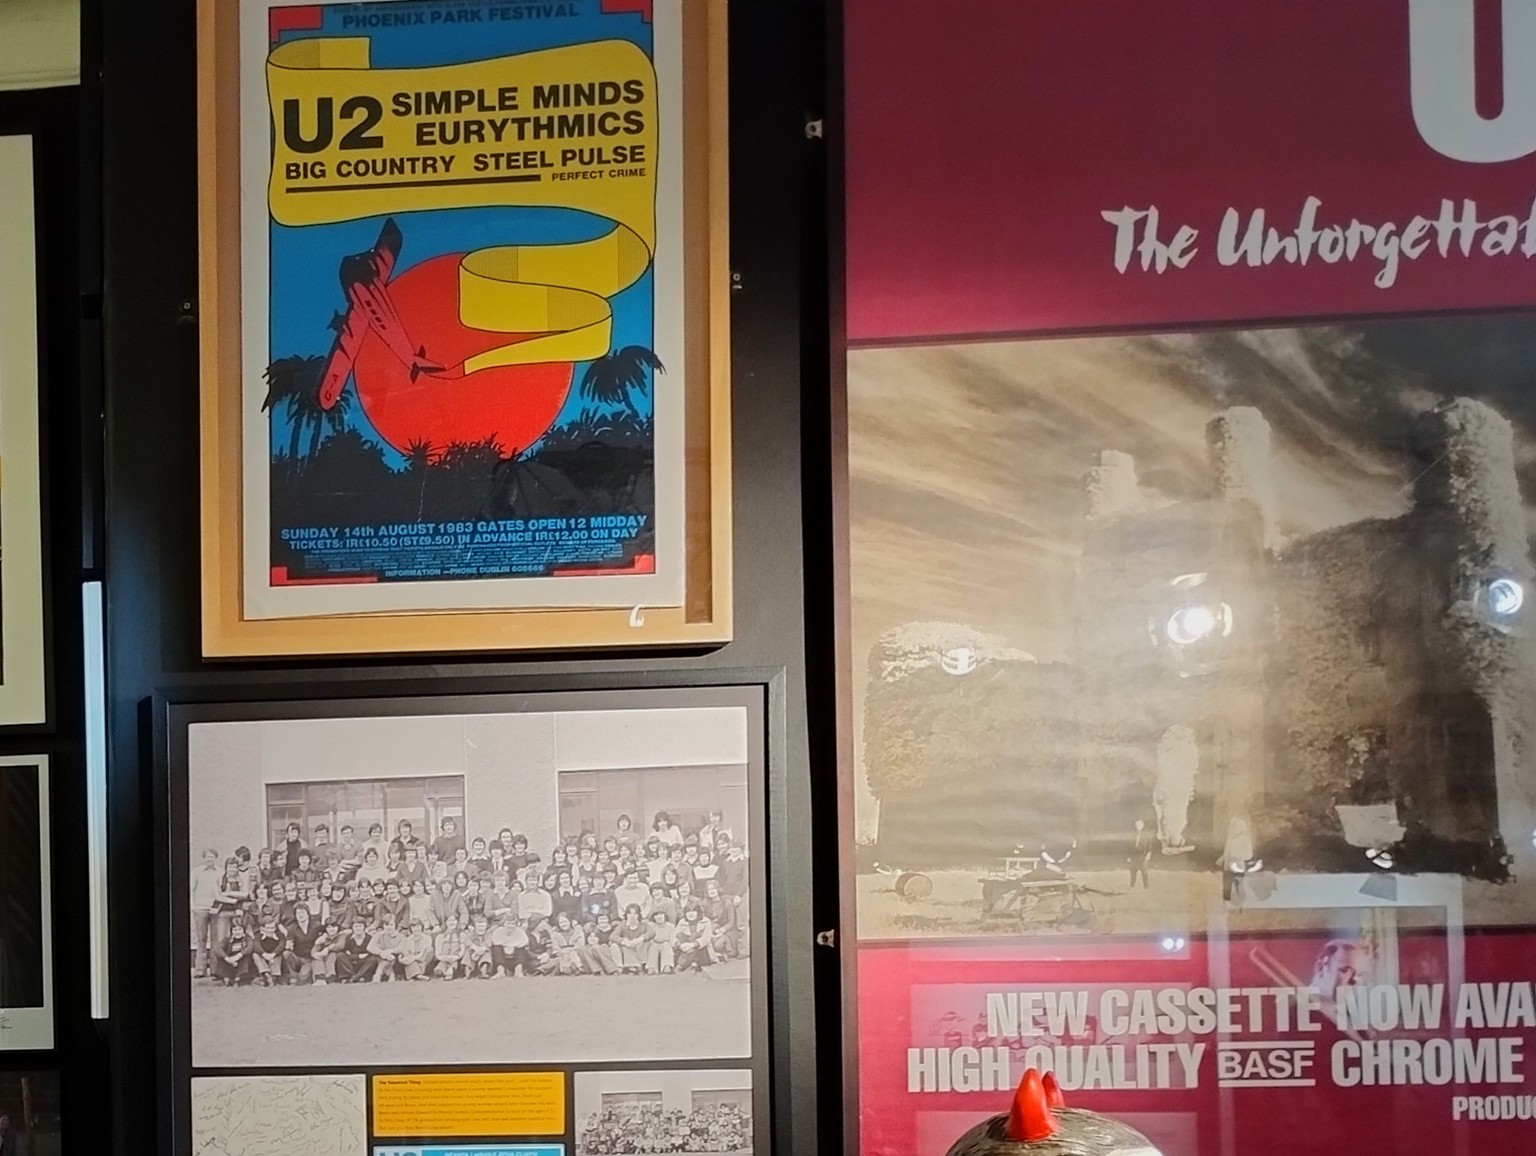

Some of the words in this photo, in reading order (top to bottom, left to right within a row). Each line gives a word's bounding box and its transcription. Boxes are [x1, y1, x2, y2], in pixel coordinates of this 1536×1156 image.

[342, 11, 425, 29] PHOENIX
[430, 8, 482, 24] PARK
[488, 4, 580, 22] FESTIVAL
[391, 86, 519, 118] SIMPLE
[532, 79, 644, 111] MINDS
[283, 94, 384, 154] U2
[416, 110, 644, 147] EURYTHMICS
[285, 161, 327, 180] BIG
[336, 154, 456, 178] COUNTRY
[472, 149, 554, 172] STEEL
[561, 144, 646, 168] PULSE
[551, 170, 605, 183] PERFECT
[608, 167, 646, 179] CRIME
[1101, 204, 1199, 275] The
[281, 527, 339, 540] SUNDAY
[344, 526, 374, 537] 14th
[378, 523, 435, 536] AUGUST
[438, 522, 474, 534] 1983
[477, 520, 524, 532] GATES
[528, 518, 566, 531] OPEN
[569, 518, 587, 529] 12
[590, 515, 647, 528] MIDDAY
[474, 531, 532, 543] ADVANCE
[591, 529, 609, 539] ON
[612, 527, 638, 538] DAY
[987, 991, 1089, 1037] NEW
[1100, 987, 1322, 1035] CASSETTE
[1336, 983, 1444, 1032] NOW
[907, 1046, 1010, 1093] HIGH
[1218, 1049, 1314, 1080] BASF
[1331, 1037, 1524, 1087] CHROME
